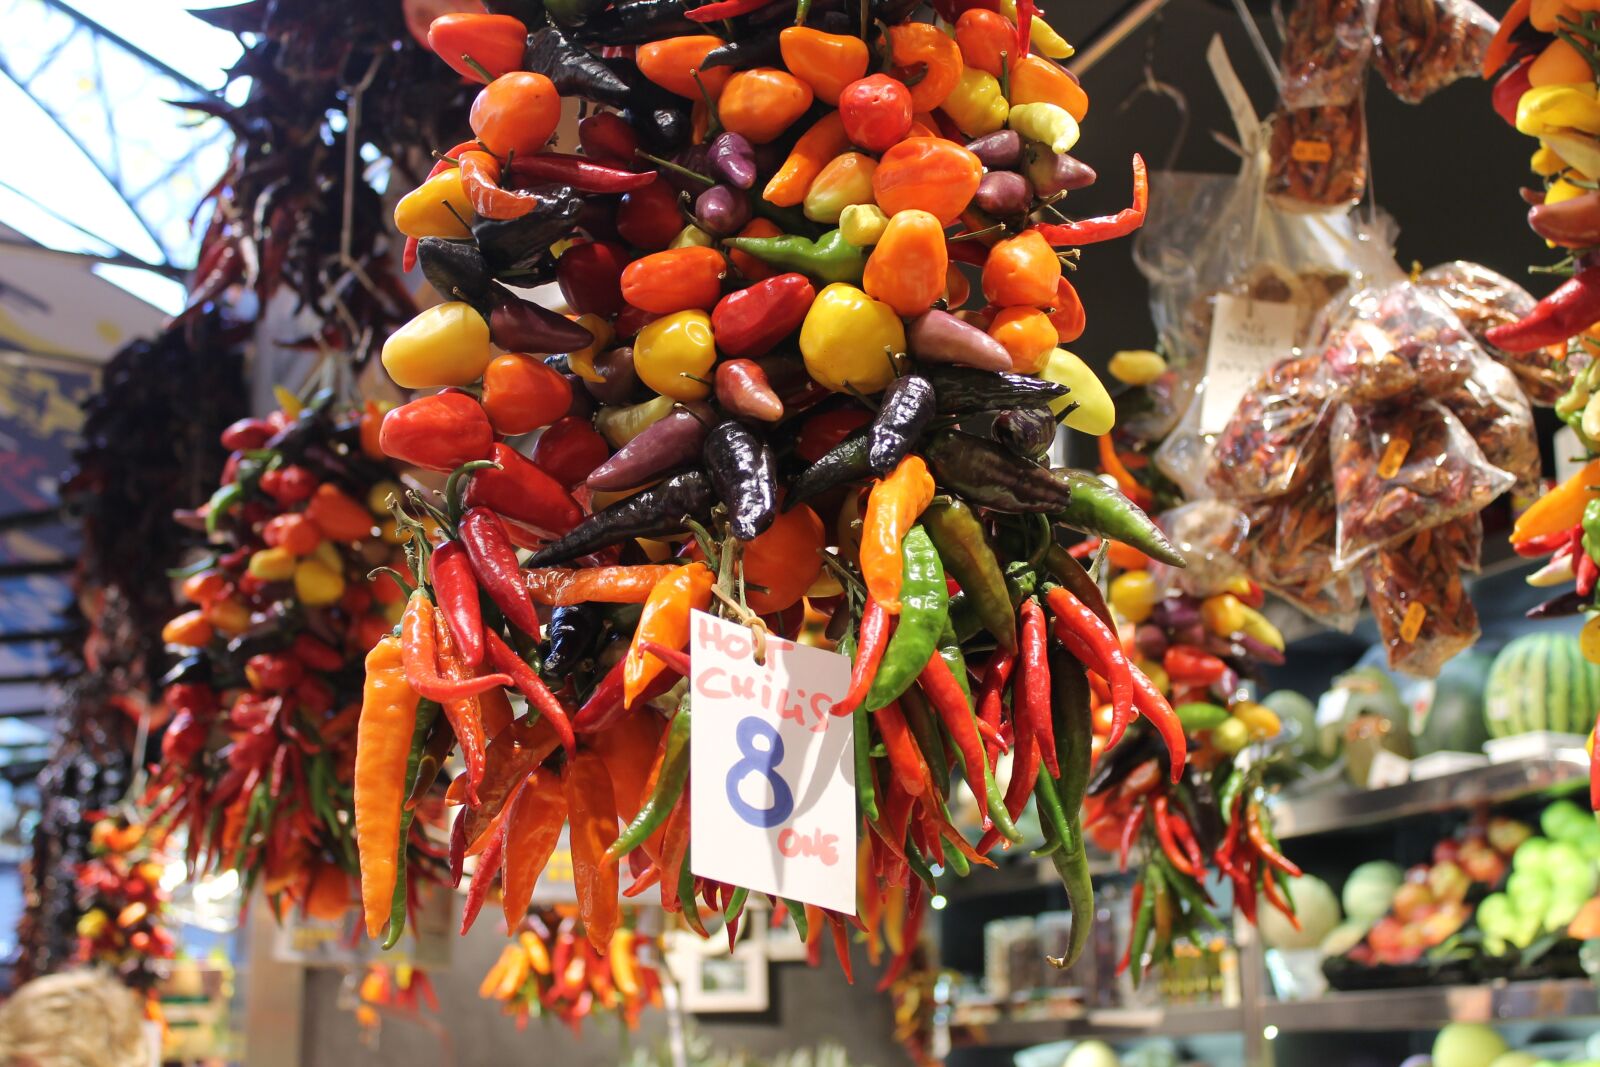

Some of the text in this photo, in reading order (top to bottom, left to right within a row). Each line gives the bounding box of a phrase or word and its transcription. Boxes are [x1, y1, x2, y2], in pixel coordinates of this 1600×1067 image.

[698, 617, 794, 671] HOT
[725, 715, 794, 829] 8
[777, 828, 839, 866] ONE
